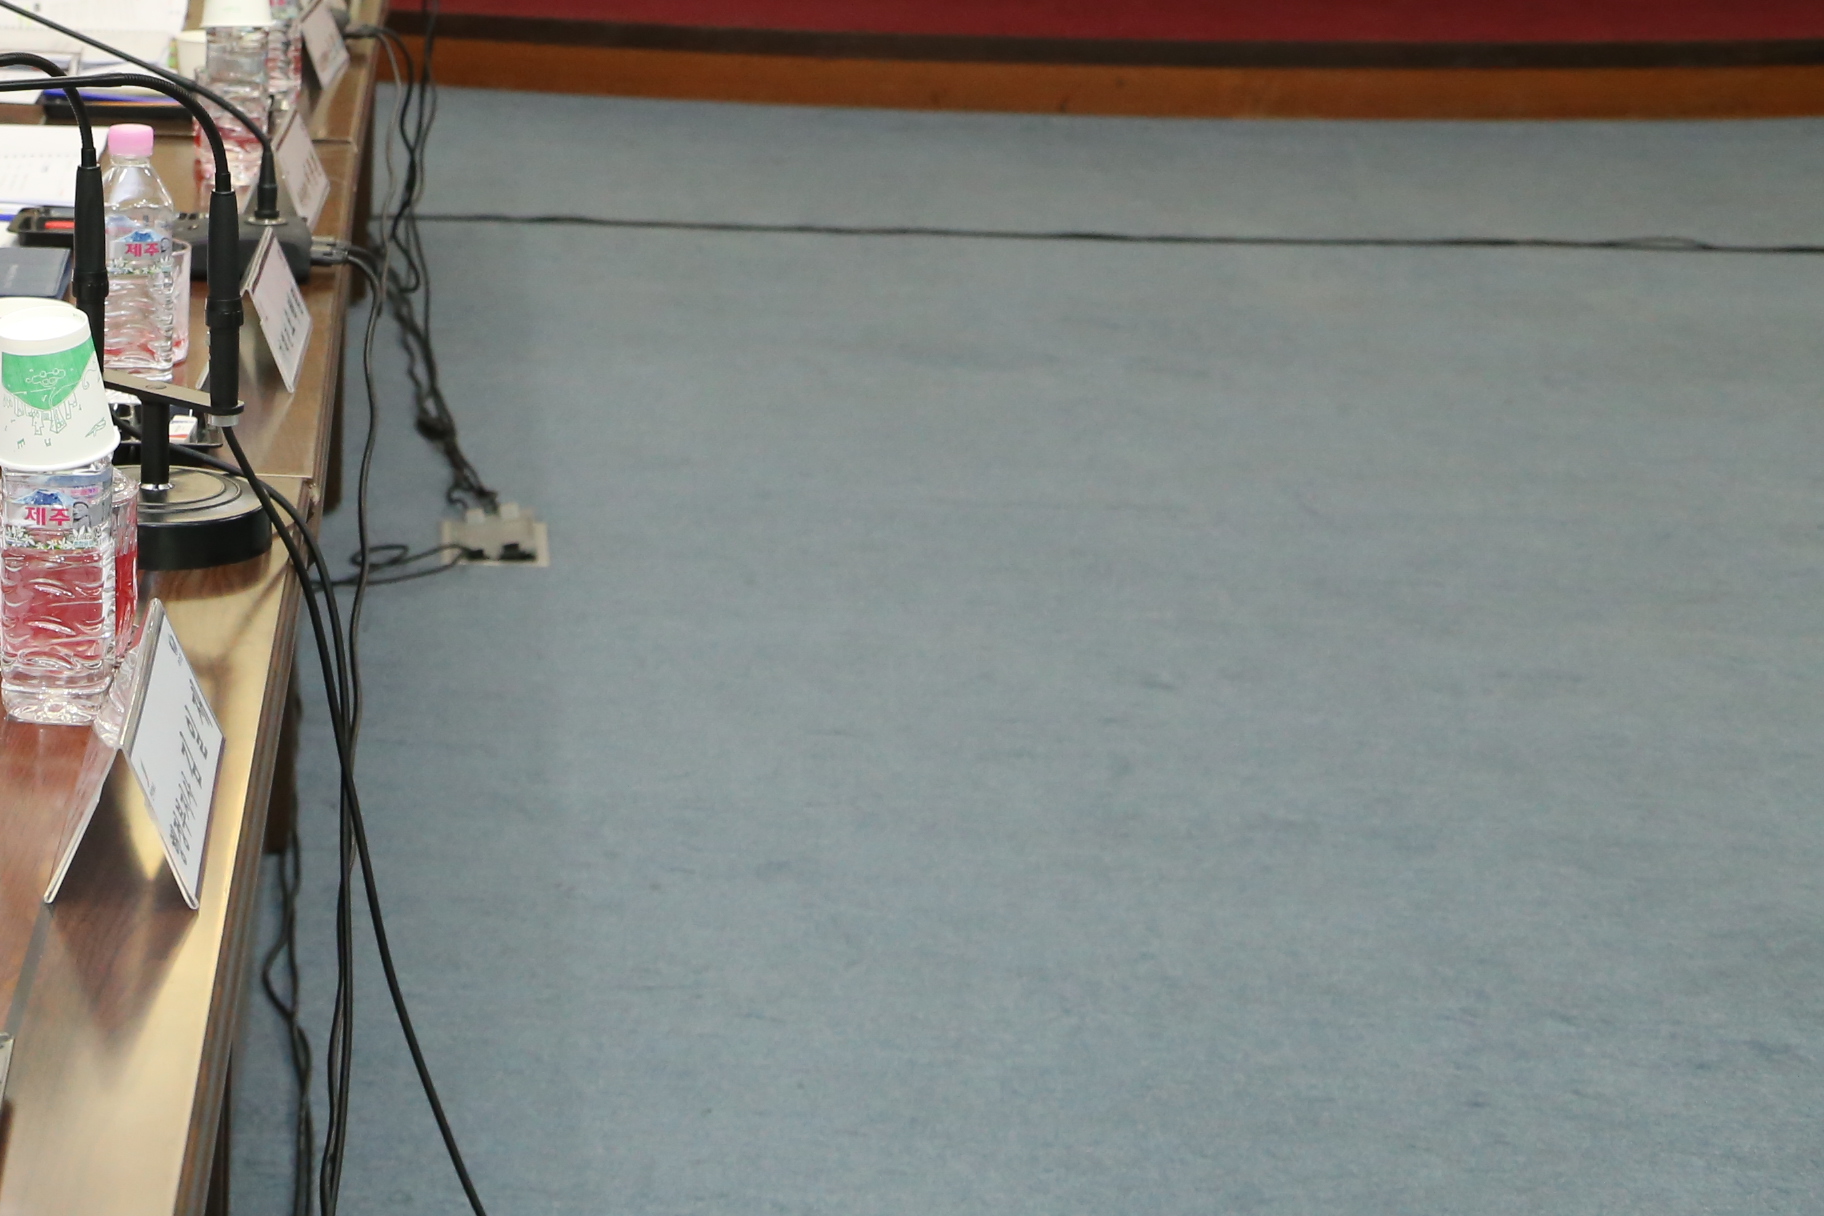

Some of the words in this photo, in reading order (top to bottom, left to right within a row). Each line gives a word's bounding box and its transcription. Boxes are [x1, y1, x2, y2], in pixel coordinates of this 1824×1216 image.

[125, 242, 160, 257] 제주
[24, 506, 71, 527] 제주
[170, 771, 197, 865] 행정부지사
